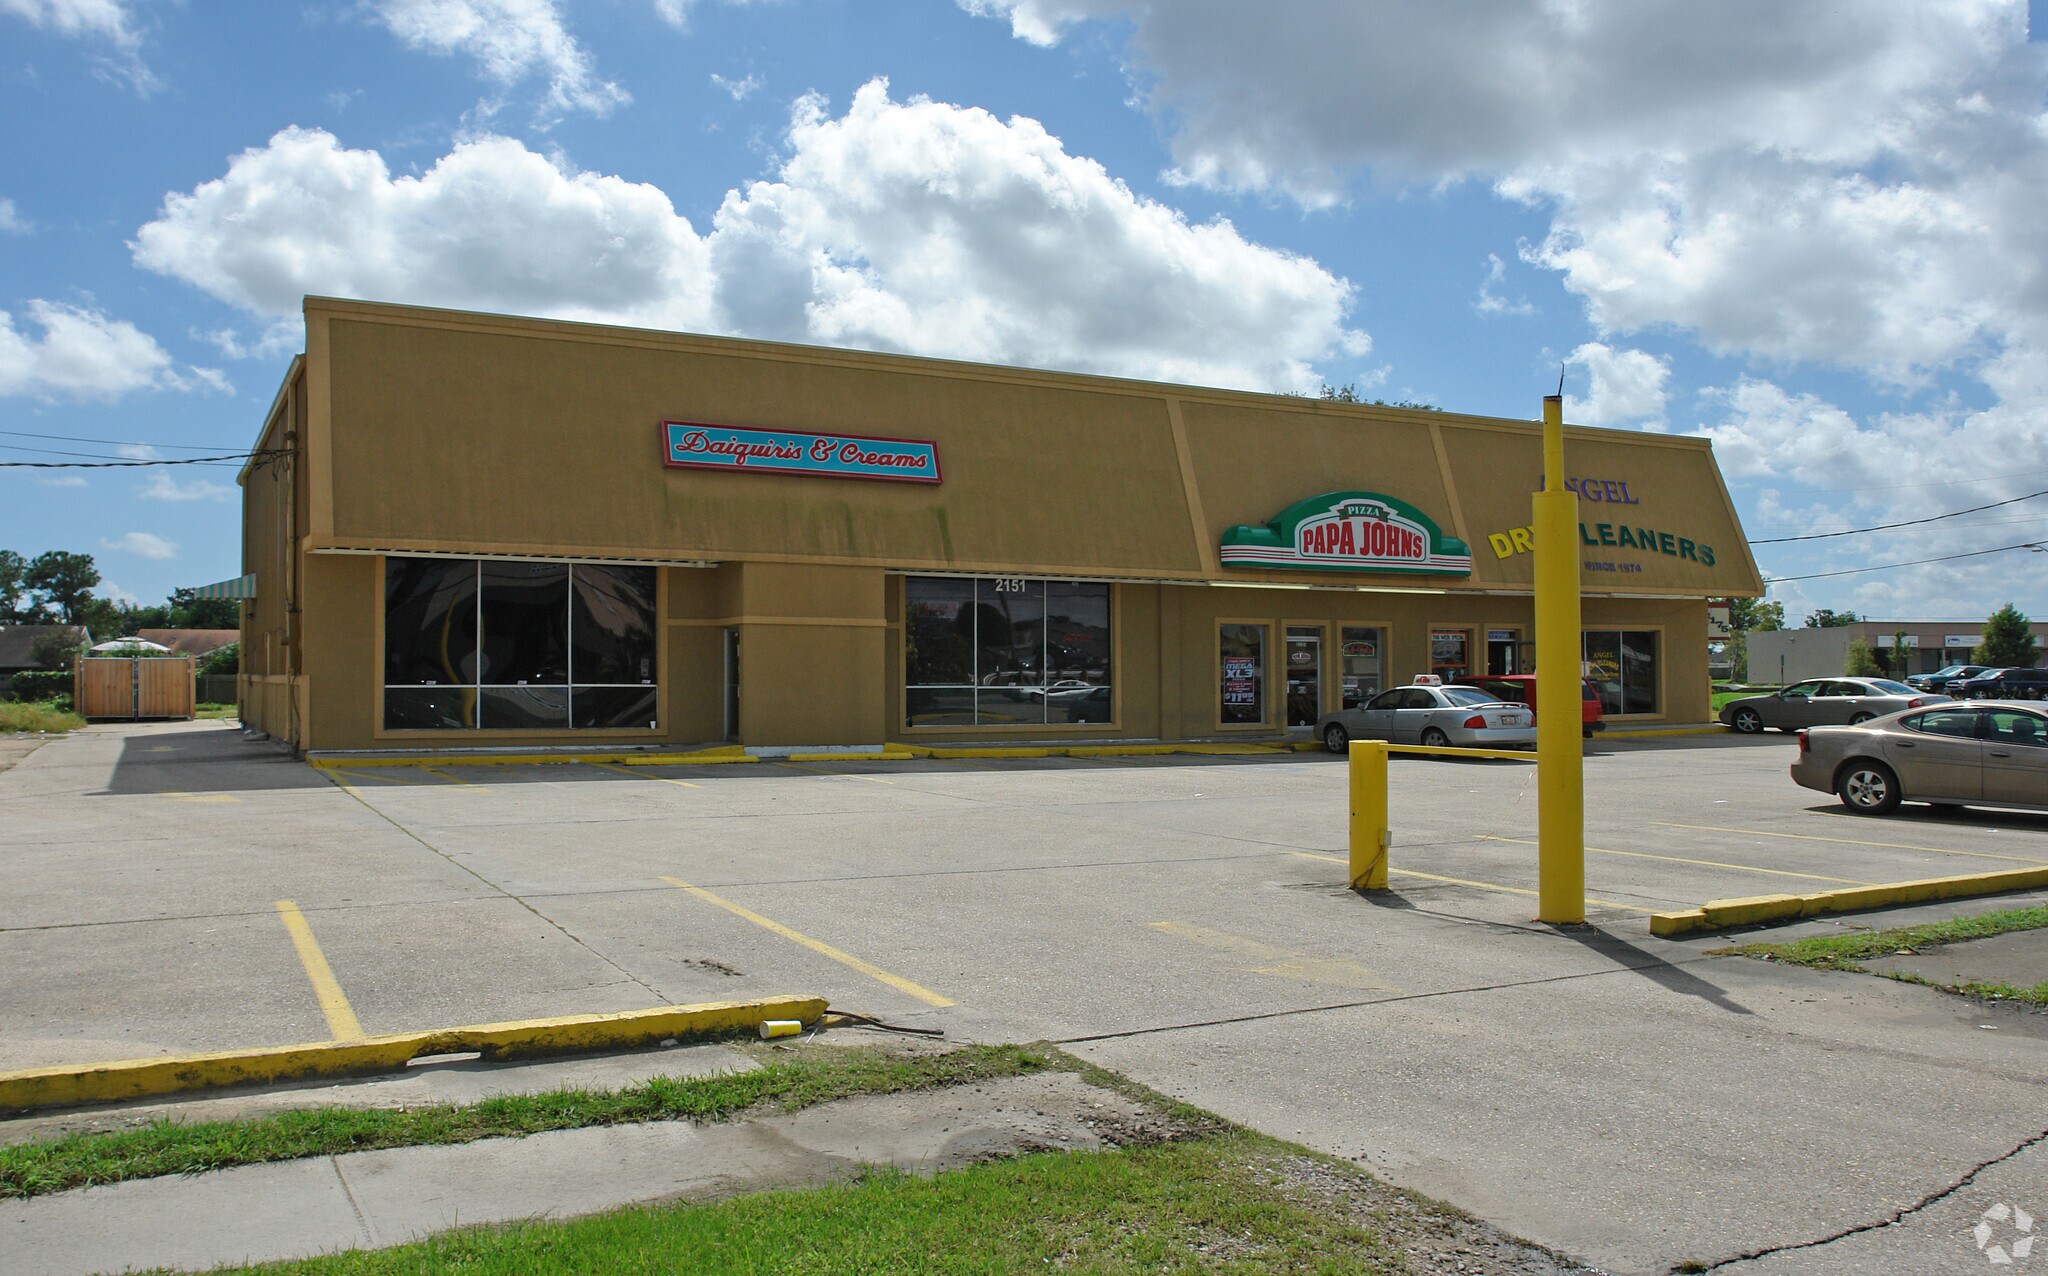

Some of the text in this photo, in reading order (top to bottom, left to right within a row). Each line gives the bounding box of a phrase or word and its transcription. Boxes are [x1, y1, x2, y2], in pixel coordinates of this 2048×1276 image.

[675, 430, 928, 469] Daiquiris & Creams
[1540, 475, 1640, 505] NGEL
[1346, 505, 1381, 517] PIZZA
[1303, 521, 1423, 559] PAPA JOHN'S
[1578, 522, 1716, 567] LEANERS
[1584, 560, 1643, 573] SINCE 1974
[995, 579, 1026, 592] 2151
[1708, 612, 1729, 633] 175
[1225, 669, 1254, 679] XL3
